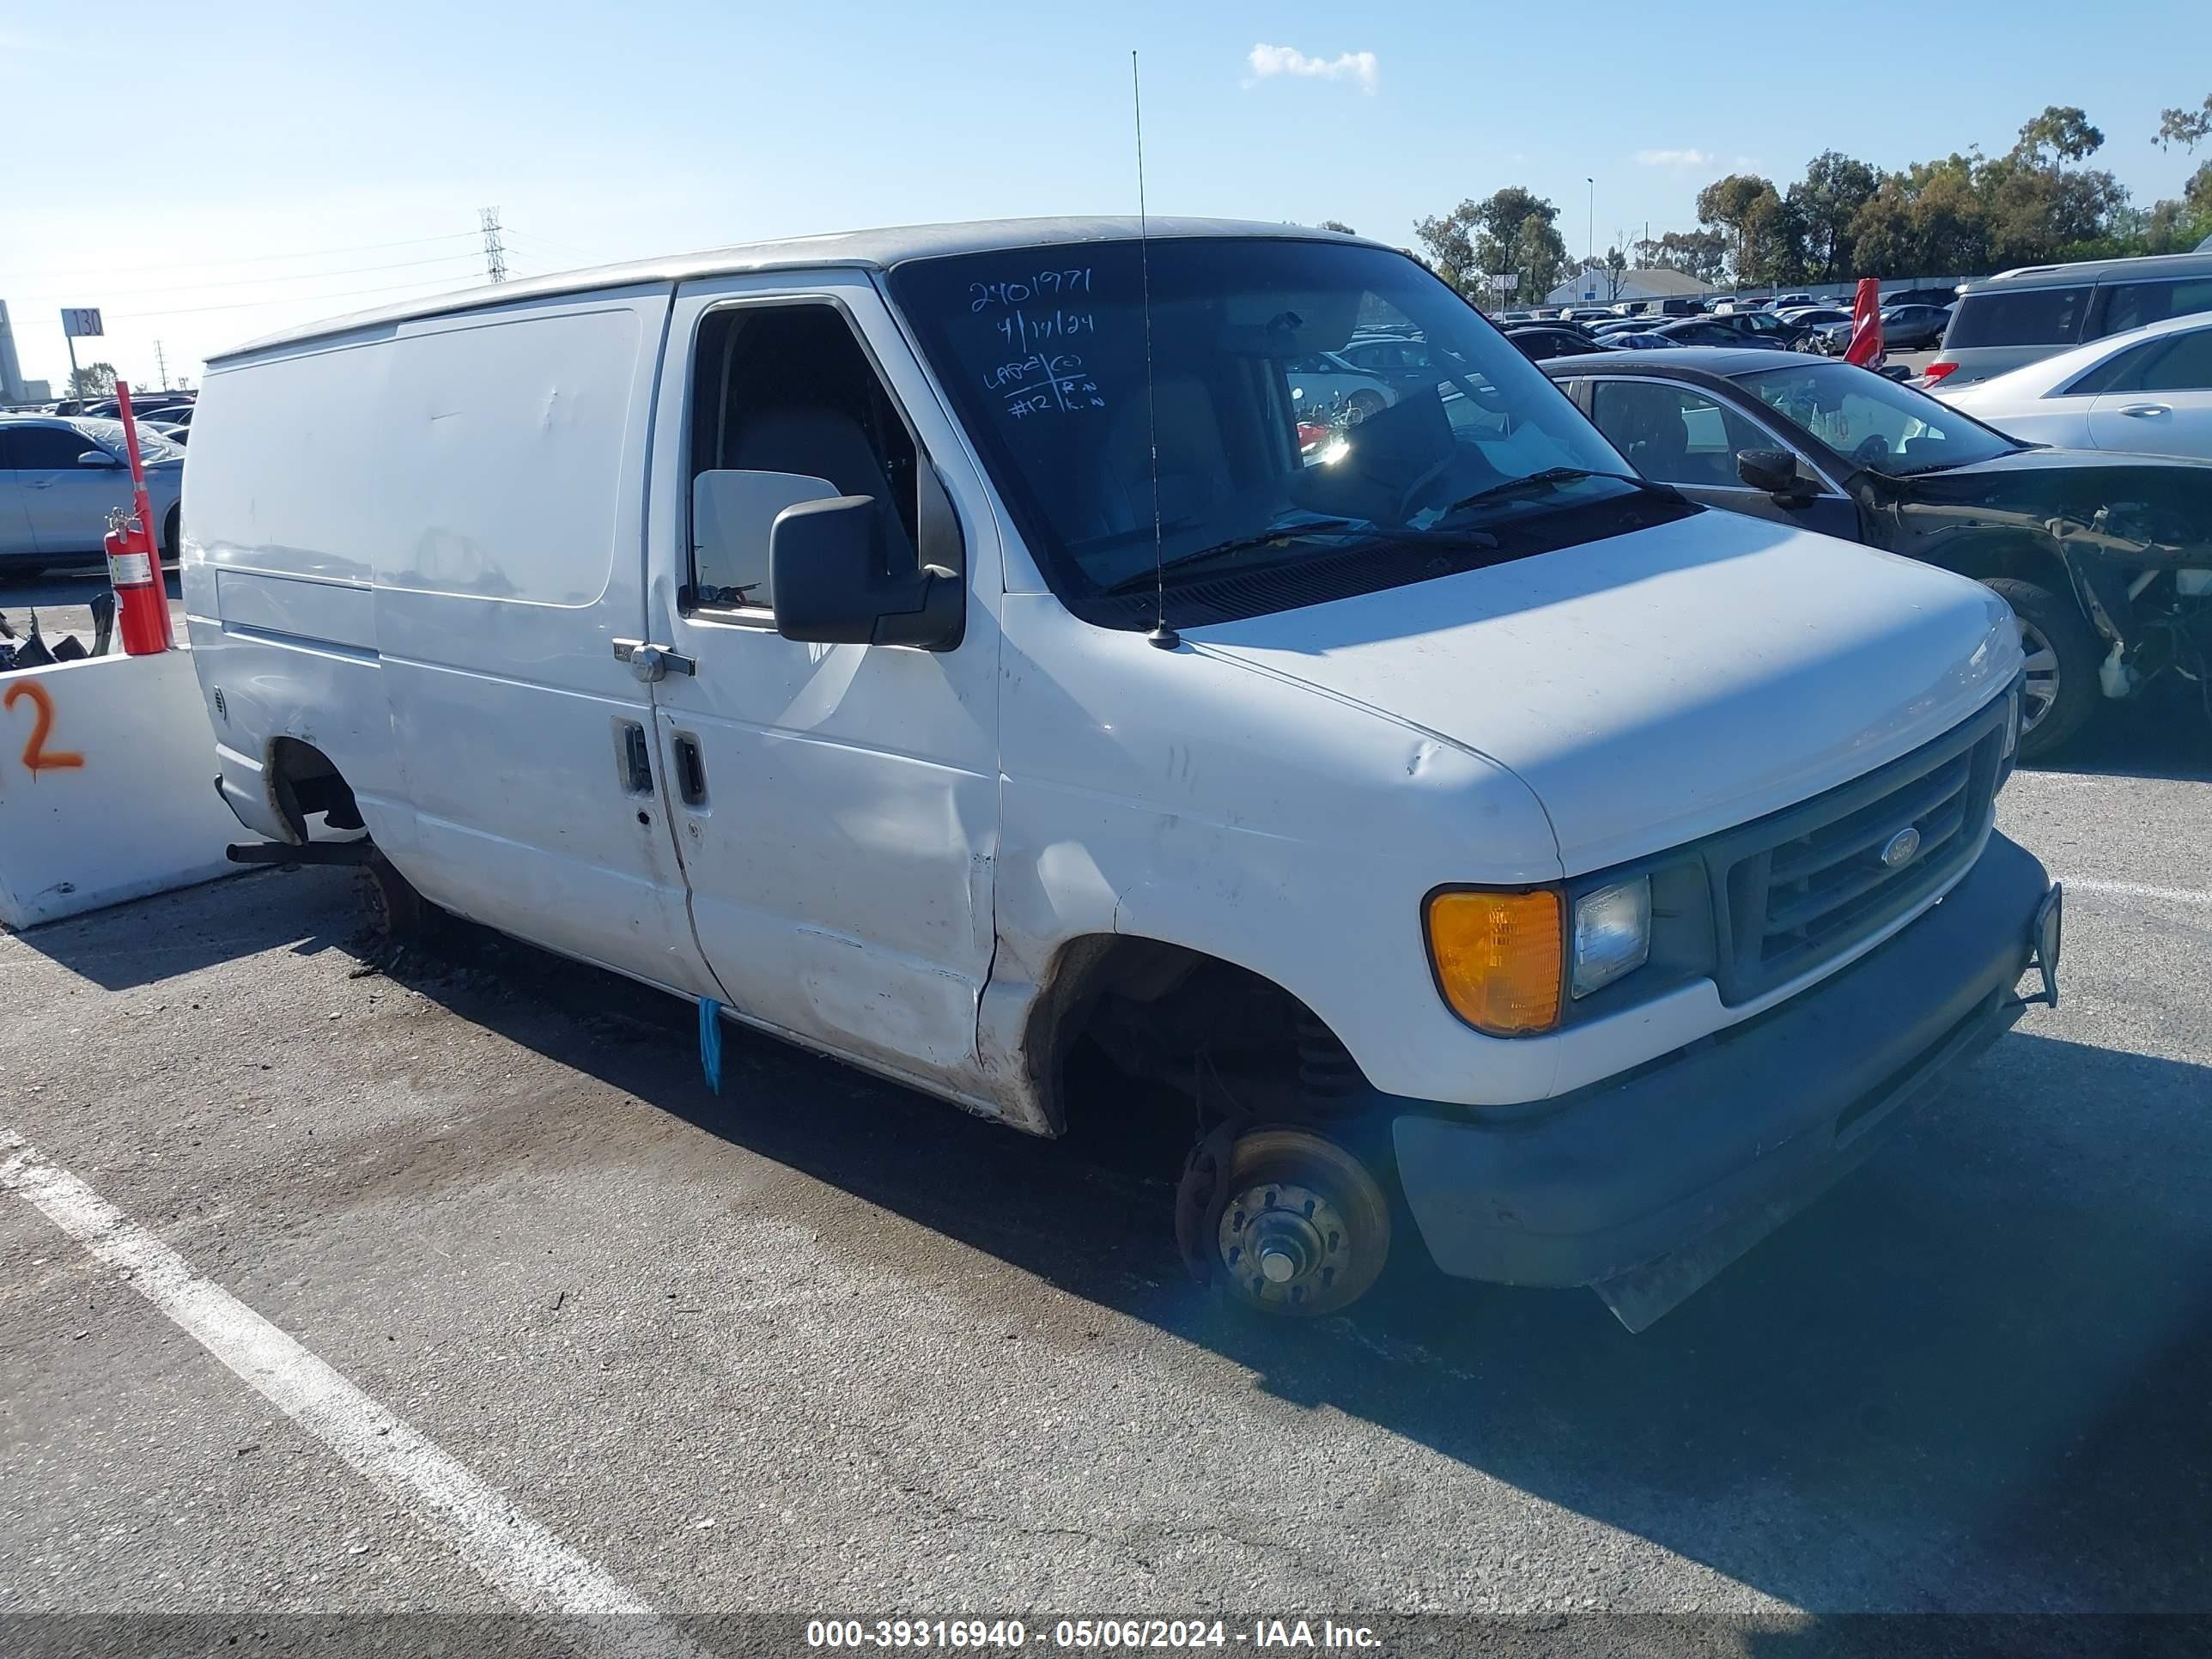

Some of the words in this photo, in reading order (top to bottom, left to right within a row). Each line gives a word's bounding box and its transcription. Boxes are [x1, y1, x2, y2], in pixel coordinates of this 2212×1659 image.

[969, 268, 1091, 312] 2401971
[74, 309, 101, 335] 130
[1007, 395, 1052, 419] #12
[4, 678, 84, 773] 2
